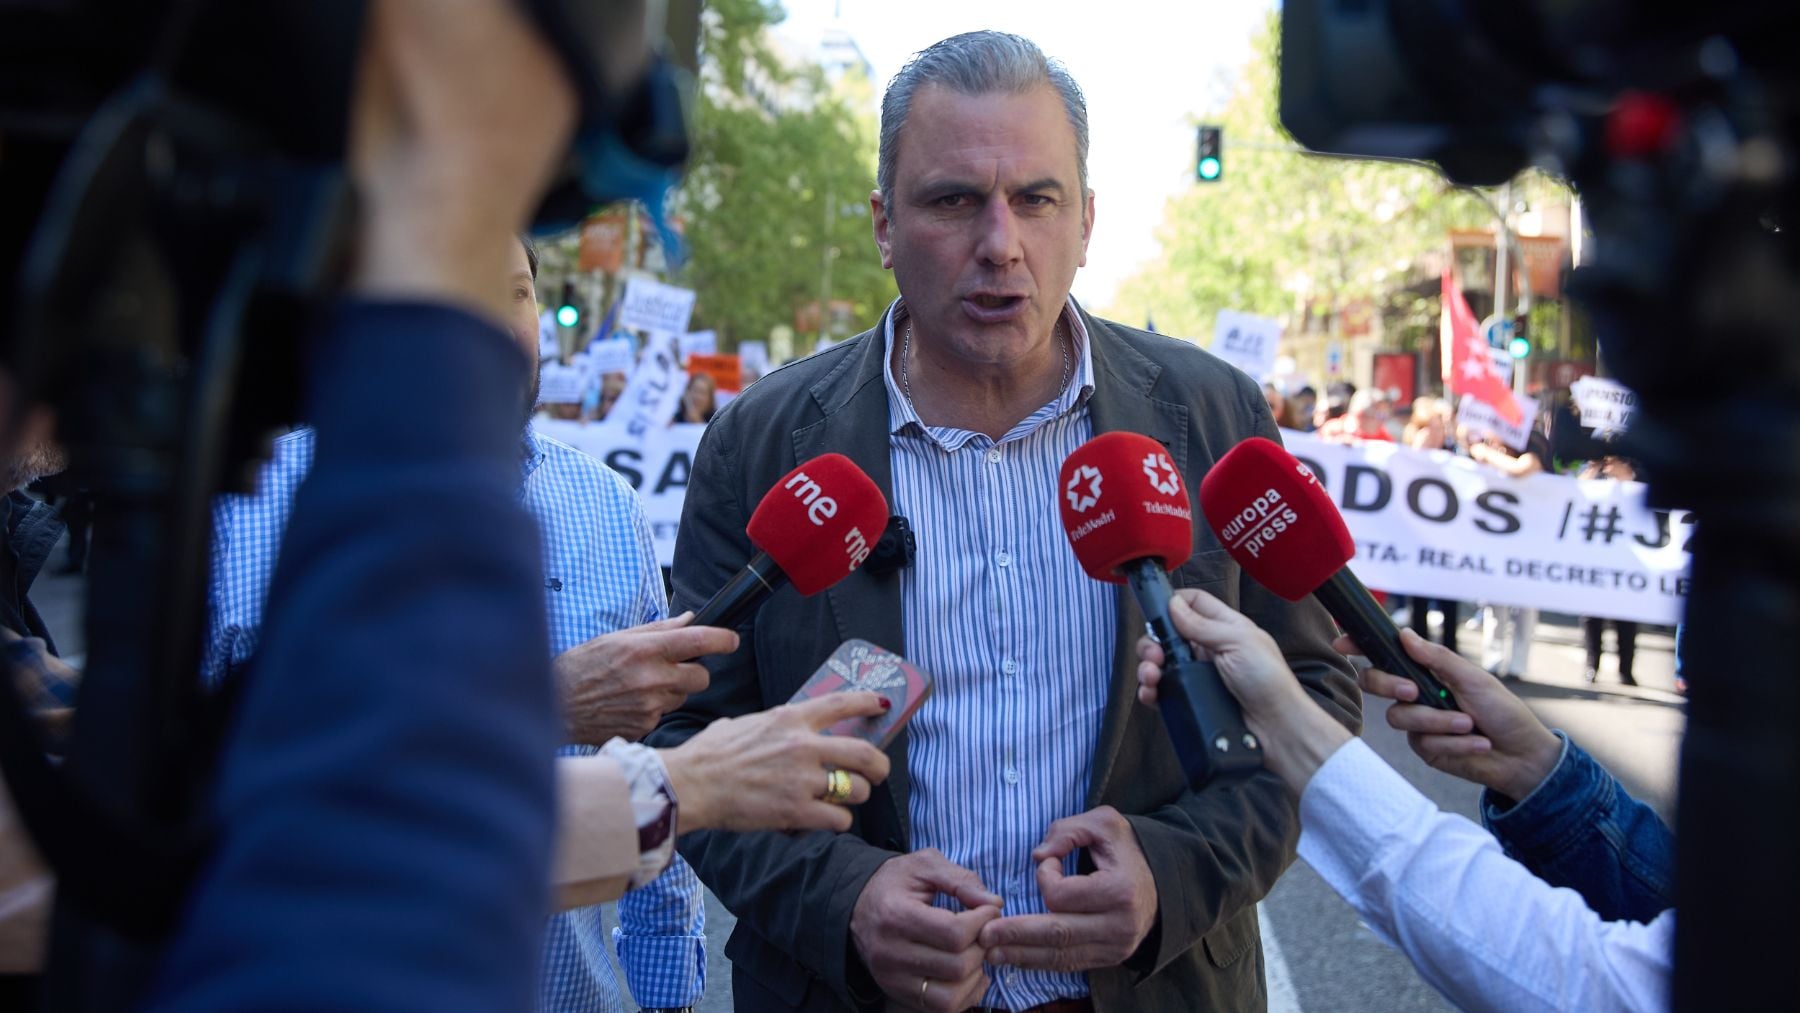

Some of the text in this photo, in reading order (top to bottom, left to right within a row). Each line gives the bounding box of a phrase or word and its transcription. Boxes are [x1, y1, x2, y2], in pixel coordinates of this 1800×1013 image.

[785, 471, 838, 527] rne
[1221, 488, 1282, 541] europa
[844, 526, 871, 572] rne
[1244, 508, 1298, 559] press
[1419, 547, 1494, 574] REAL
[1506, 559, 1648, 590] DECRETO
